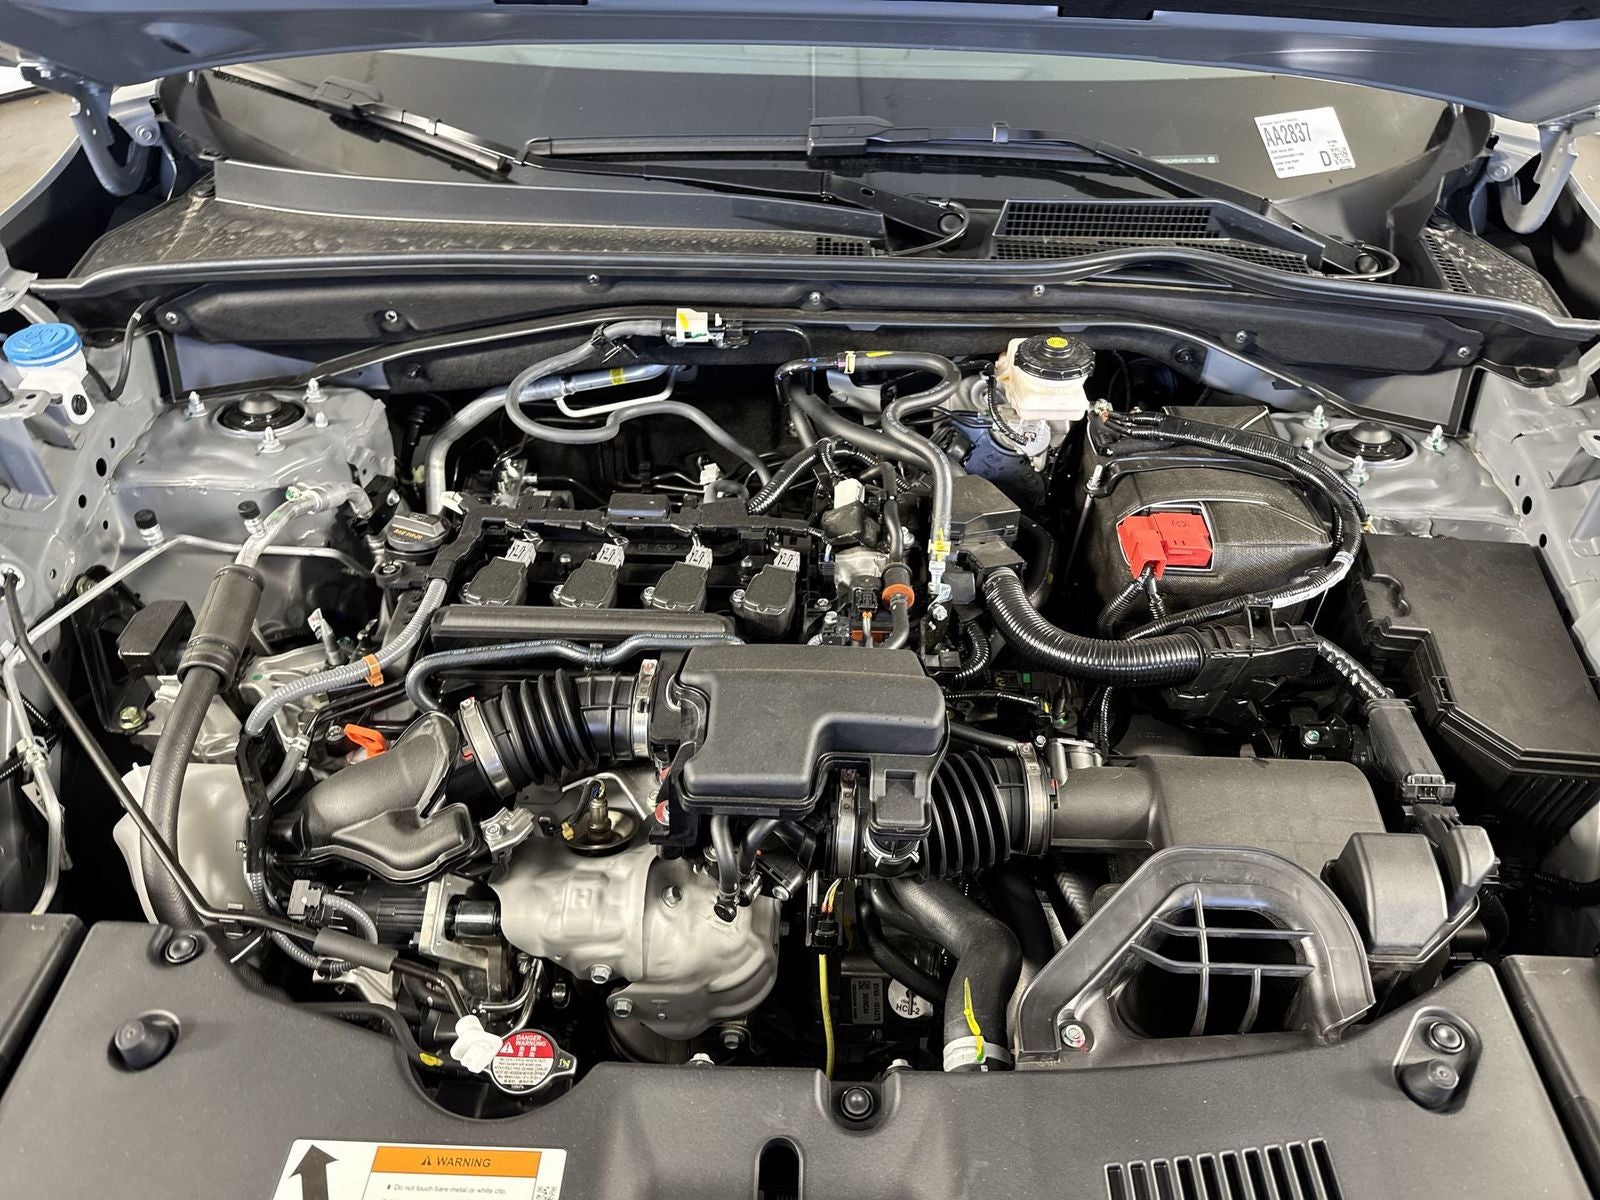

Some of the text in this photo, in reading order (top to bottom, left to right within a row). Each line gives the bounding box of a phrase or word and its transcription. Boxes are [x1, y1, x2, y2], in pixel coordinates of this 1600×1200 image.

[1263, 122, 1312, 148] AA2837
[1319, 150, 1332, 167] D
[895, 1003, 920, 1015] HC-2
[436, 1156, 491, 1168] WARNING
